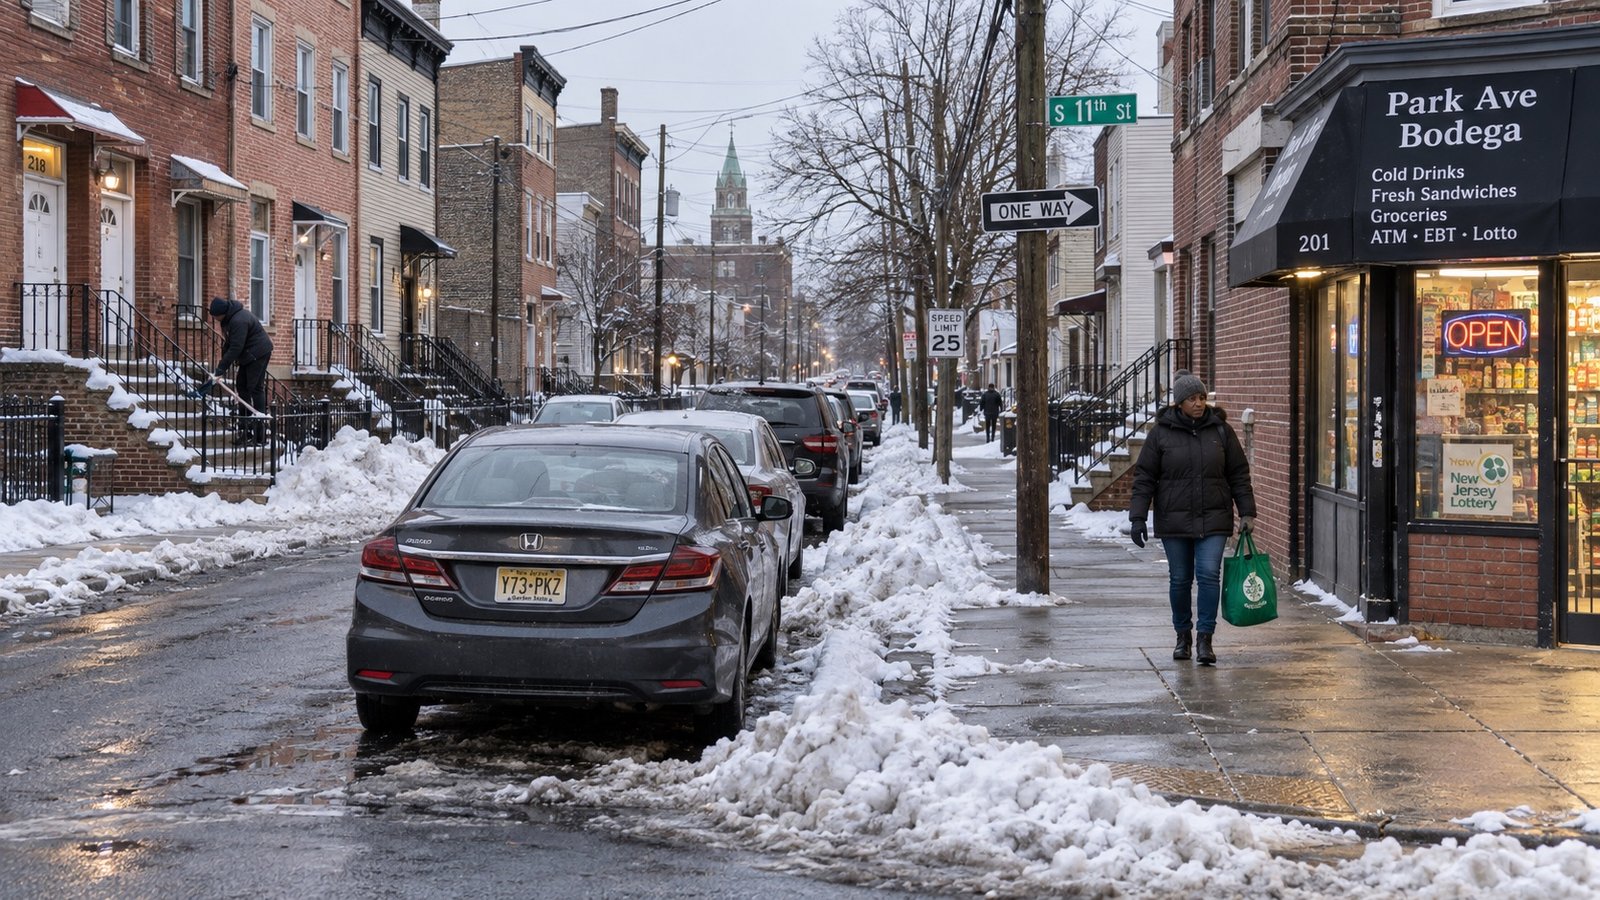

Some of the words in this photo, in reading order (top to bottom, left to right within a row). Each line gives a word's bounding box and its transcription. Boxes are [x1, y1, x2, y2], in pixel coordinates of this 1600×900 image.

[1054, 104, 1065, 123] S
[1075, 98, 1107, 122] 11th
[1116, 102, 1132, 120] St
[1385, 88, 1464, 117] Park
[1474, 86, 1538, 111] Ave
[1398, 119, 1523, 150] Bodega
[27, 154, 46, 173] 218
[1371, 167, 1408, 183] Cold
[1412, 165, 1465, 181] Drinks
[1371, 188, 1416, 203] Fresh
[1420, 184, 1518, 202] Sandwiches
[998, 203, 1032, 220] ONE
[1040, 200, 1075, 217] WAY
[1370, 208, 1448, 224] Groceries
[1298, 233, 1331, 253] 201
[1370, 228, 1407, 245] ATM
[1424, 227, 1457, 243] EBT
[1472, 226, 1518, 241] Lotto
[931, 314, 962, 323] SPEED
[934, 324, 958, 332] LIMIT
[932, 334, 960, 351] 25
[1448, 320, 1523, 347] OPEN
[1450, 472, 1480, 484] New
[1452, 484, 1497, 499] Jersey
[1450, 496, 1498, 511] Lottery
